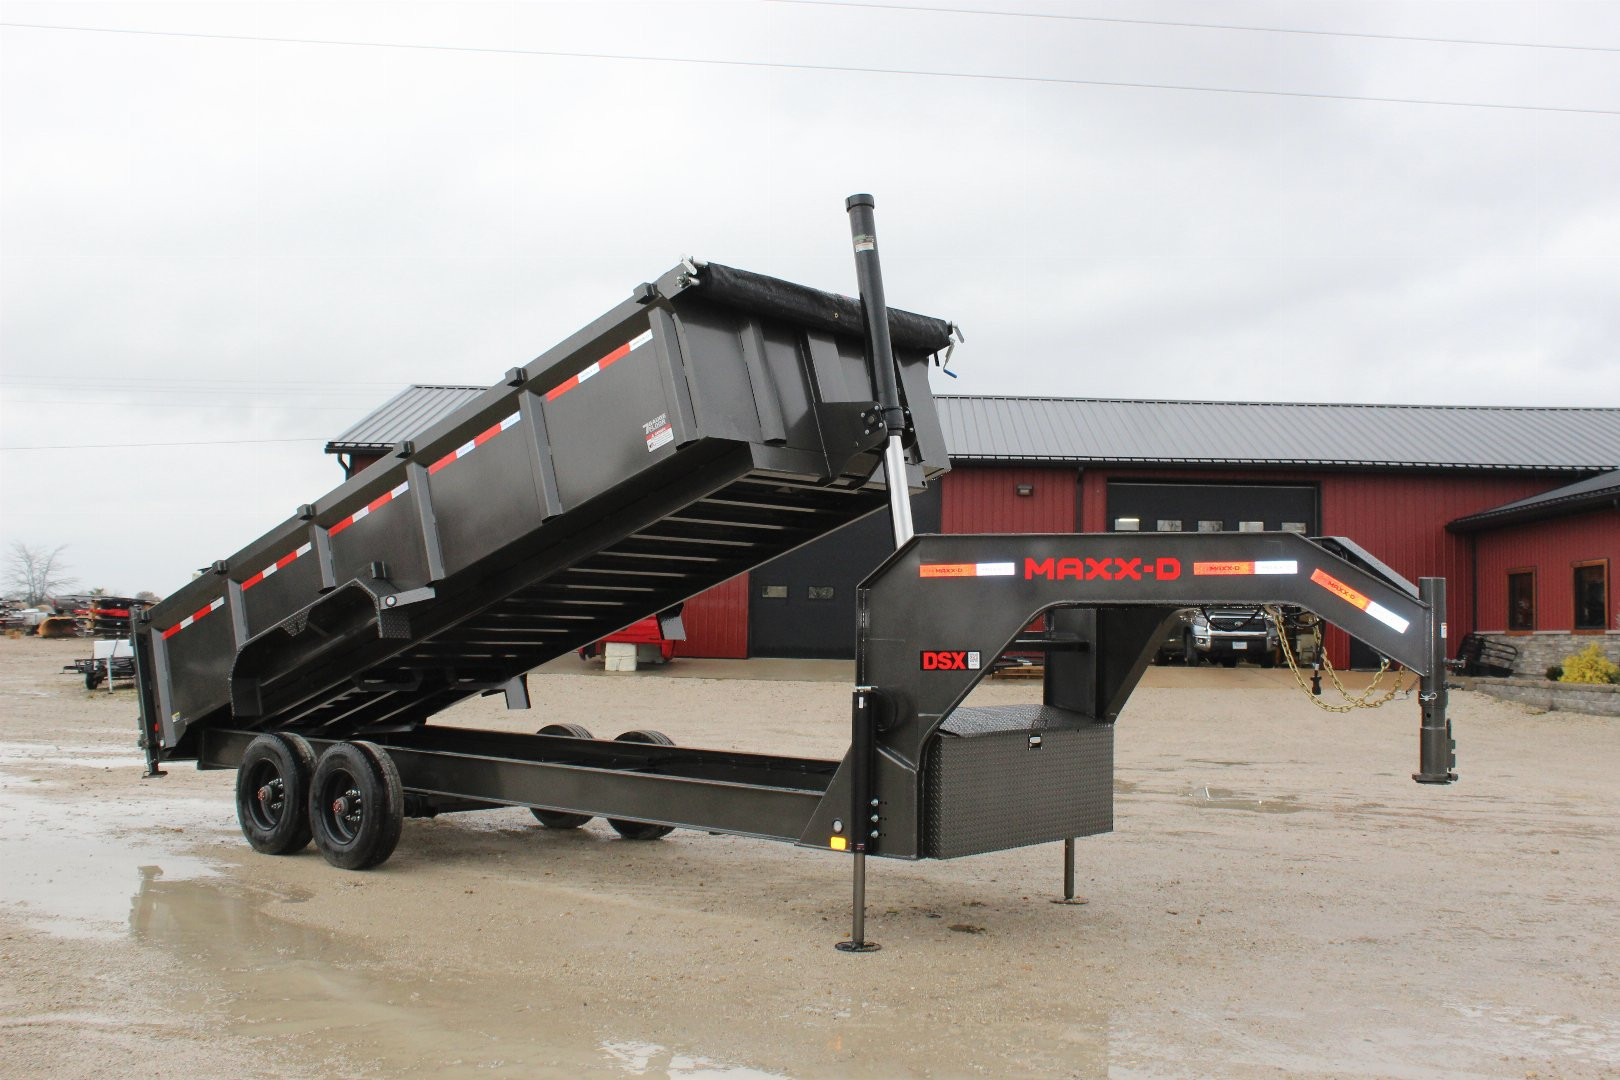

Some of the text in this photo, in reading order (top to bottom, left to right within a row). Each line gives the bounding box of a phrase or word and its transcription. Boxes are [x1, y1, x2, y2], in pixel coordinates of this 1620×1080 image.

[1024, 558, 1181, 580] MAXX-D
[1328, 580, 1356, 600] MAXX-D
[923, 652, 966, 670] DSX
